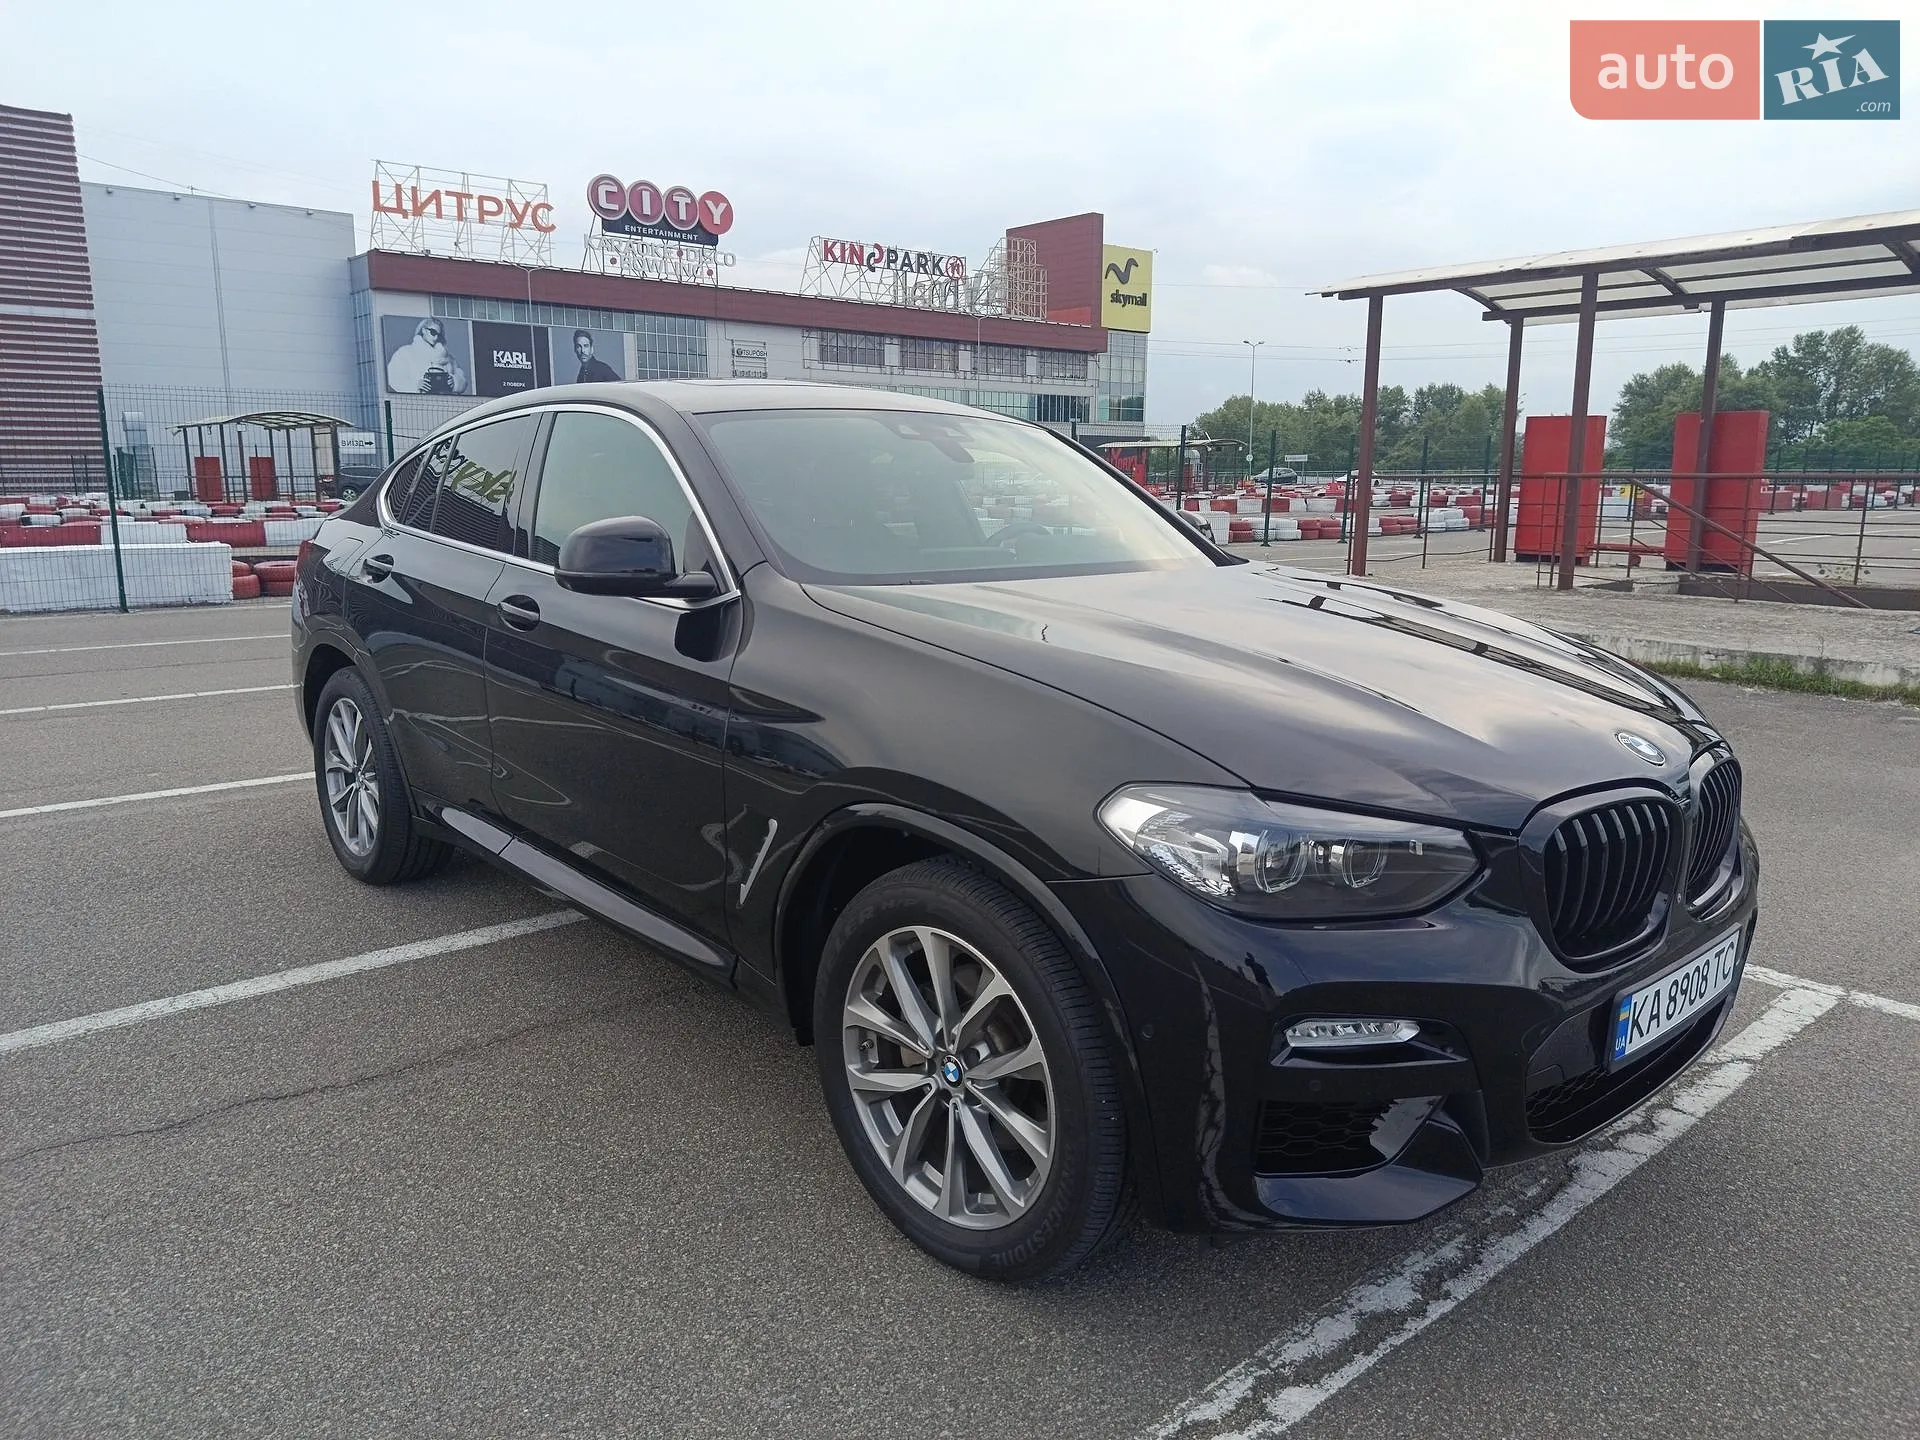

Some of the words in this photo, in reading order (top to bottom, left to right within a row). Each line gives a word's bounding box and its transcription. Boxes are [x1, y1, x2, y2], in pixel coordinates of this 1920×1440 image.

[371, 179, 557, 234] ЦИТРУС
[594, 181, 729, 227] CITY
[624, 224, 699, 241] ENTERTAINMENT
[1110, 288, 1148, 308] skymall
[493, 350, 531, 365] KARL
[1628, 988, 1661, 1045] KA
[1665, 958, 1711, 1022] 8908
[1712, 941, 1735, 988] TC
[1614, 1036, 1626, 1051] UA
